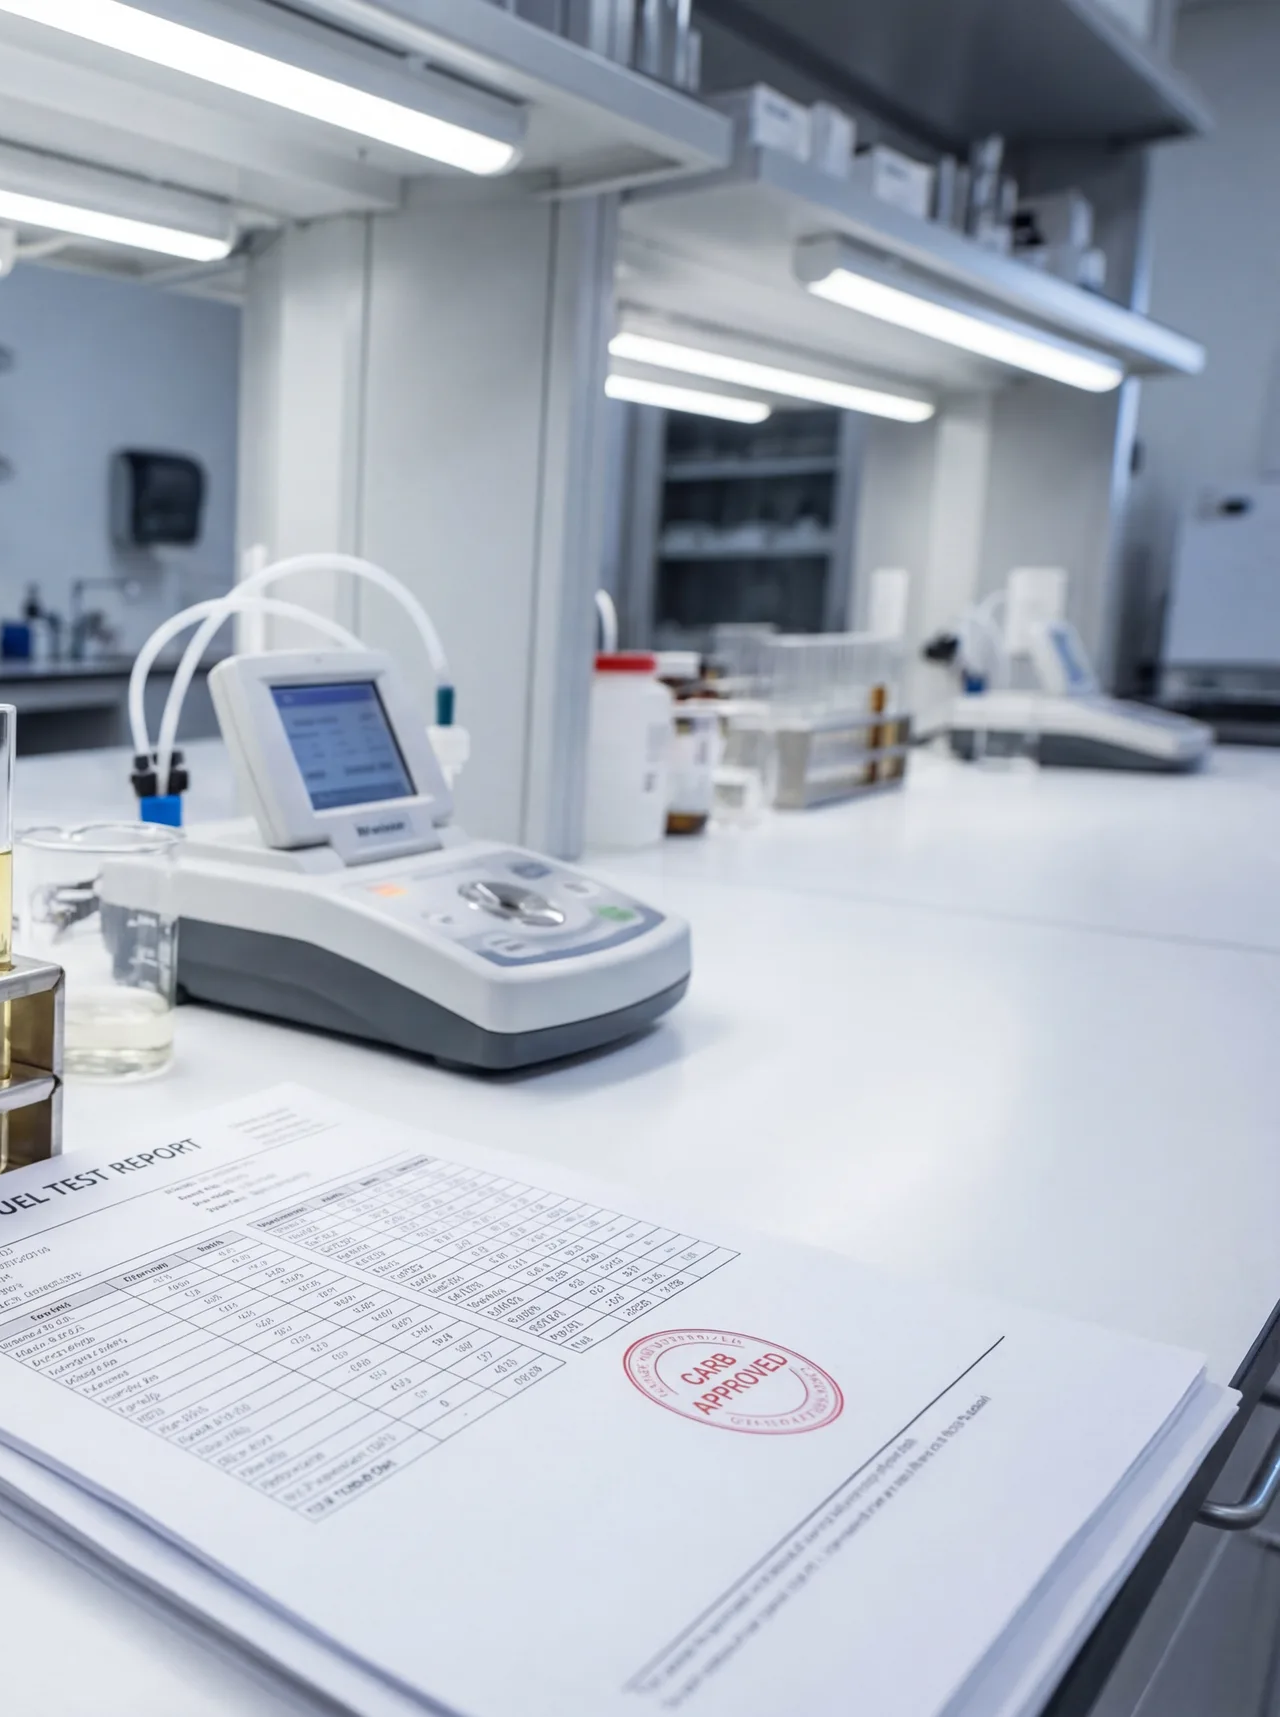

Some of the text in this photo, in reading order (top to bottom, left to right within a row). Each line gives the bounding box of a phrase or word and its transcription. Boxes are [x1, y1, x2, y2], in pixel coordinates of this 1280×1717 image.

[42, 1168, 109, 1196] TEST
[108, 1137, 202, 1175] REPORT
[680, 1352, 737, 1386] CARB
[692, 1352, 788, 1416] APPROVED
